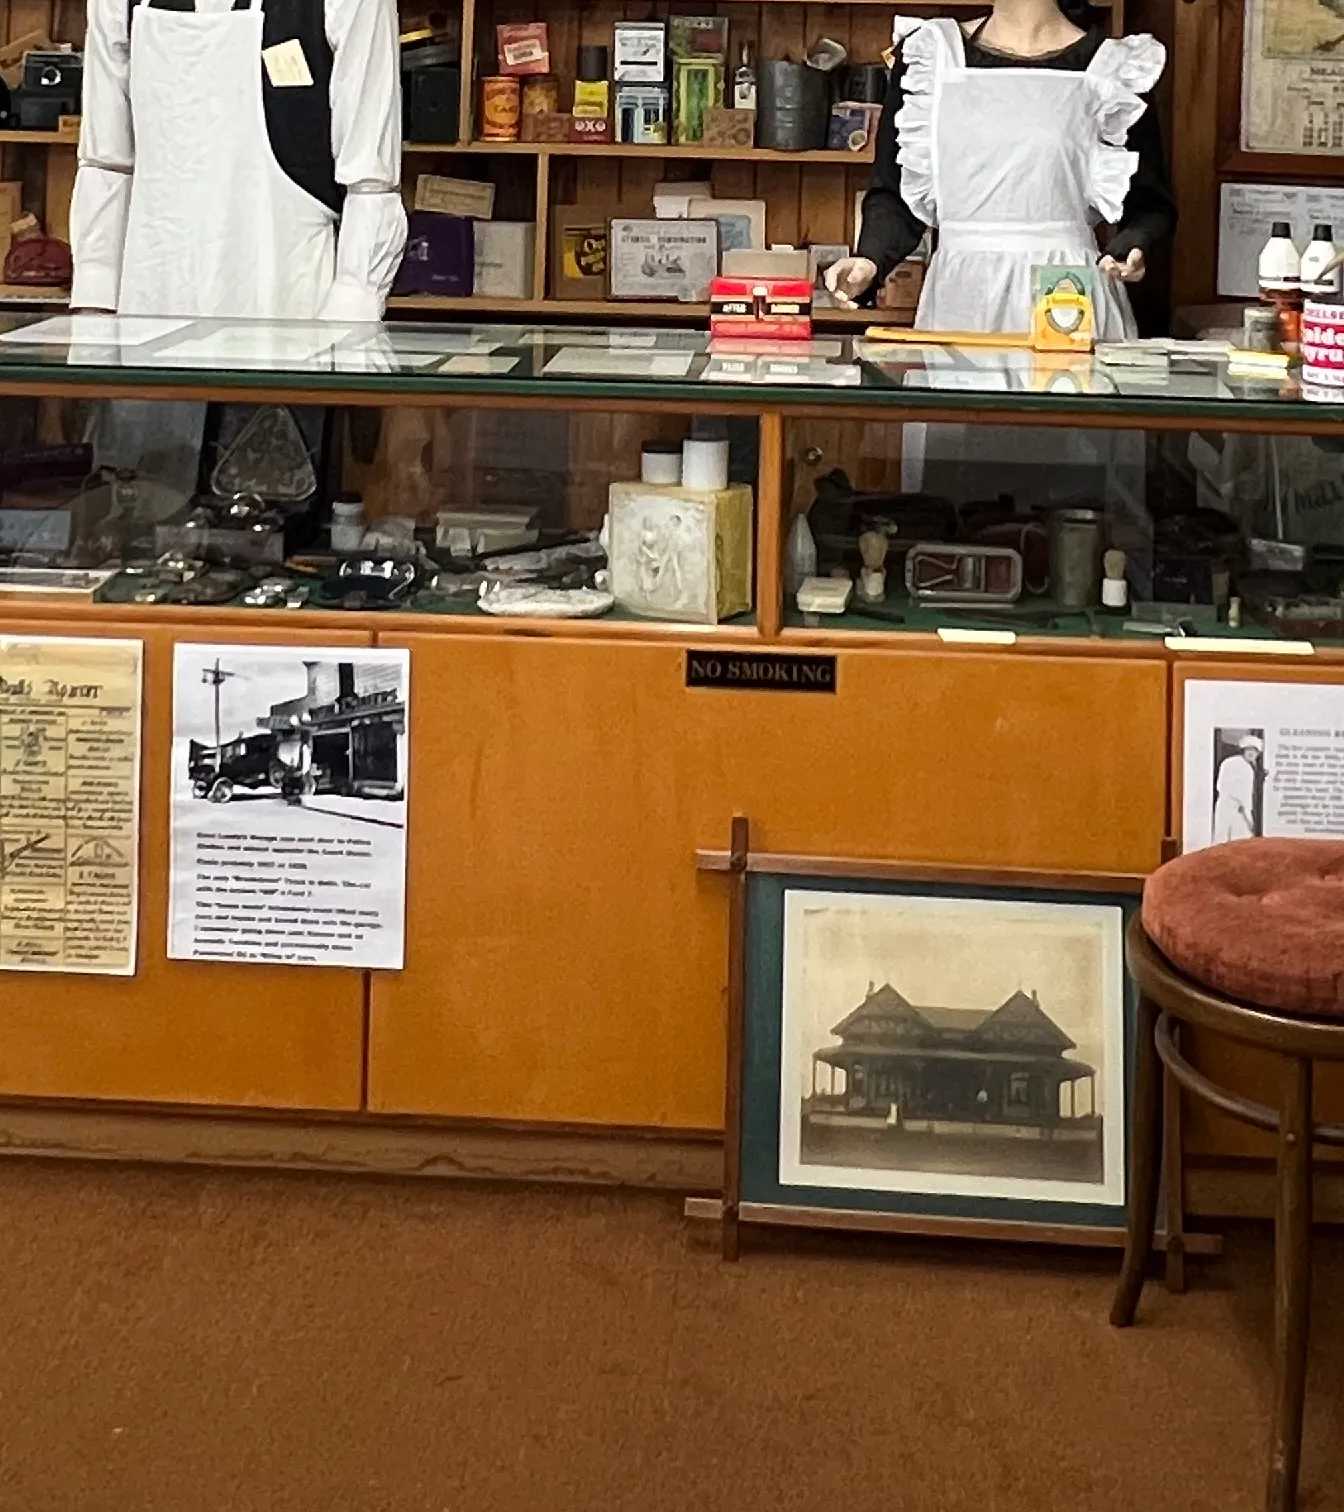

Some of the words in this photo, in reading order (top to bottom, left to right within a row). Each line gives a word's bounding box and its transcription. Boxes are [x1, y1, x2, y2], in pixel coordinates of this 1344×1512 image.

[574, 119, 607, 133] OXO
[691, 659, 723, 678] NO
[726, 661, 832, 683] SMOKING
